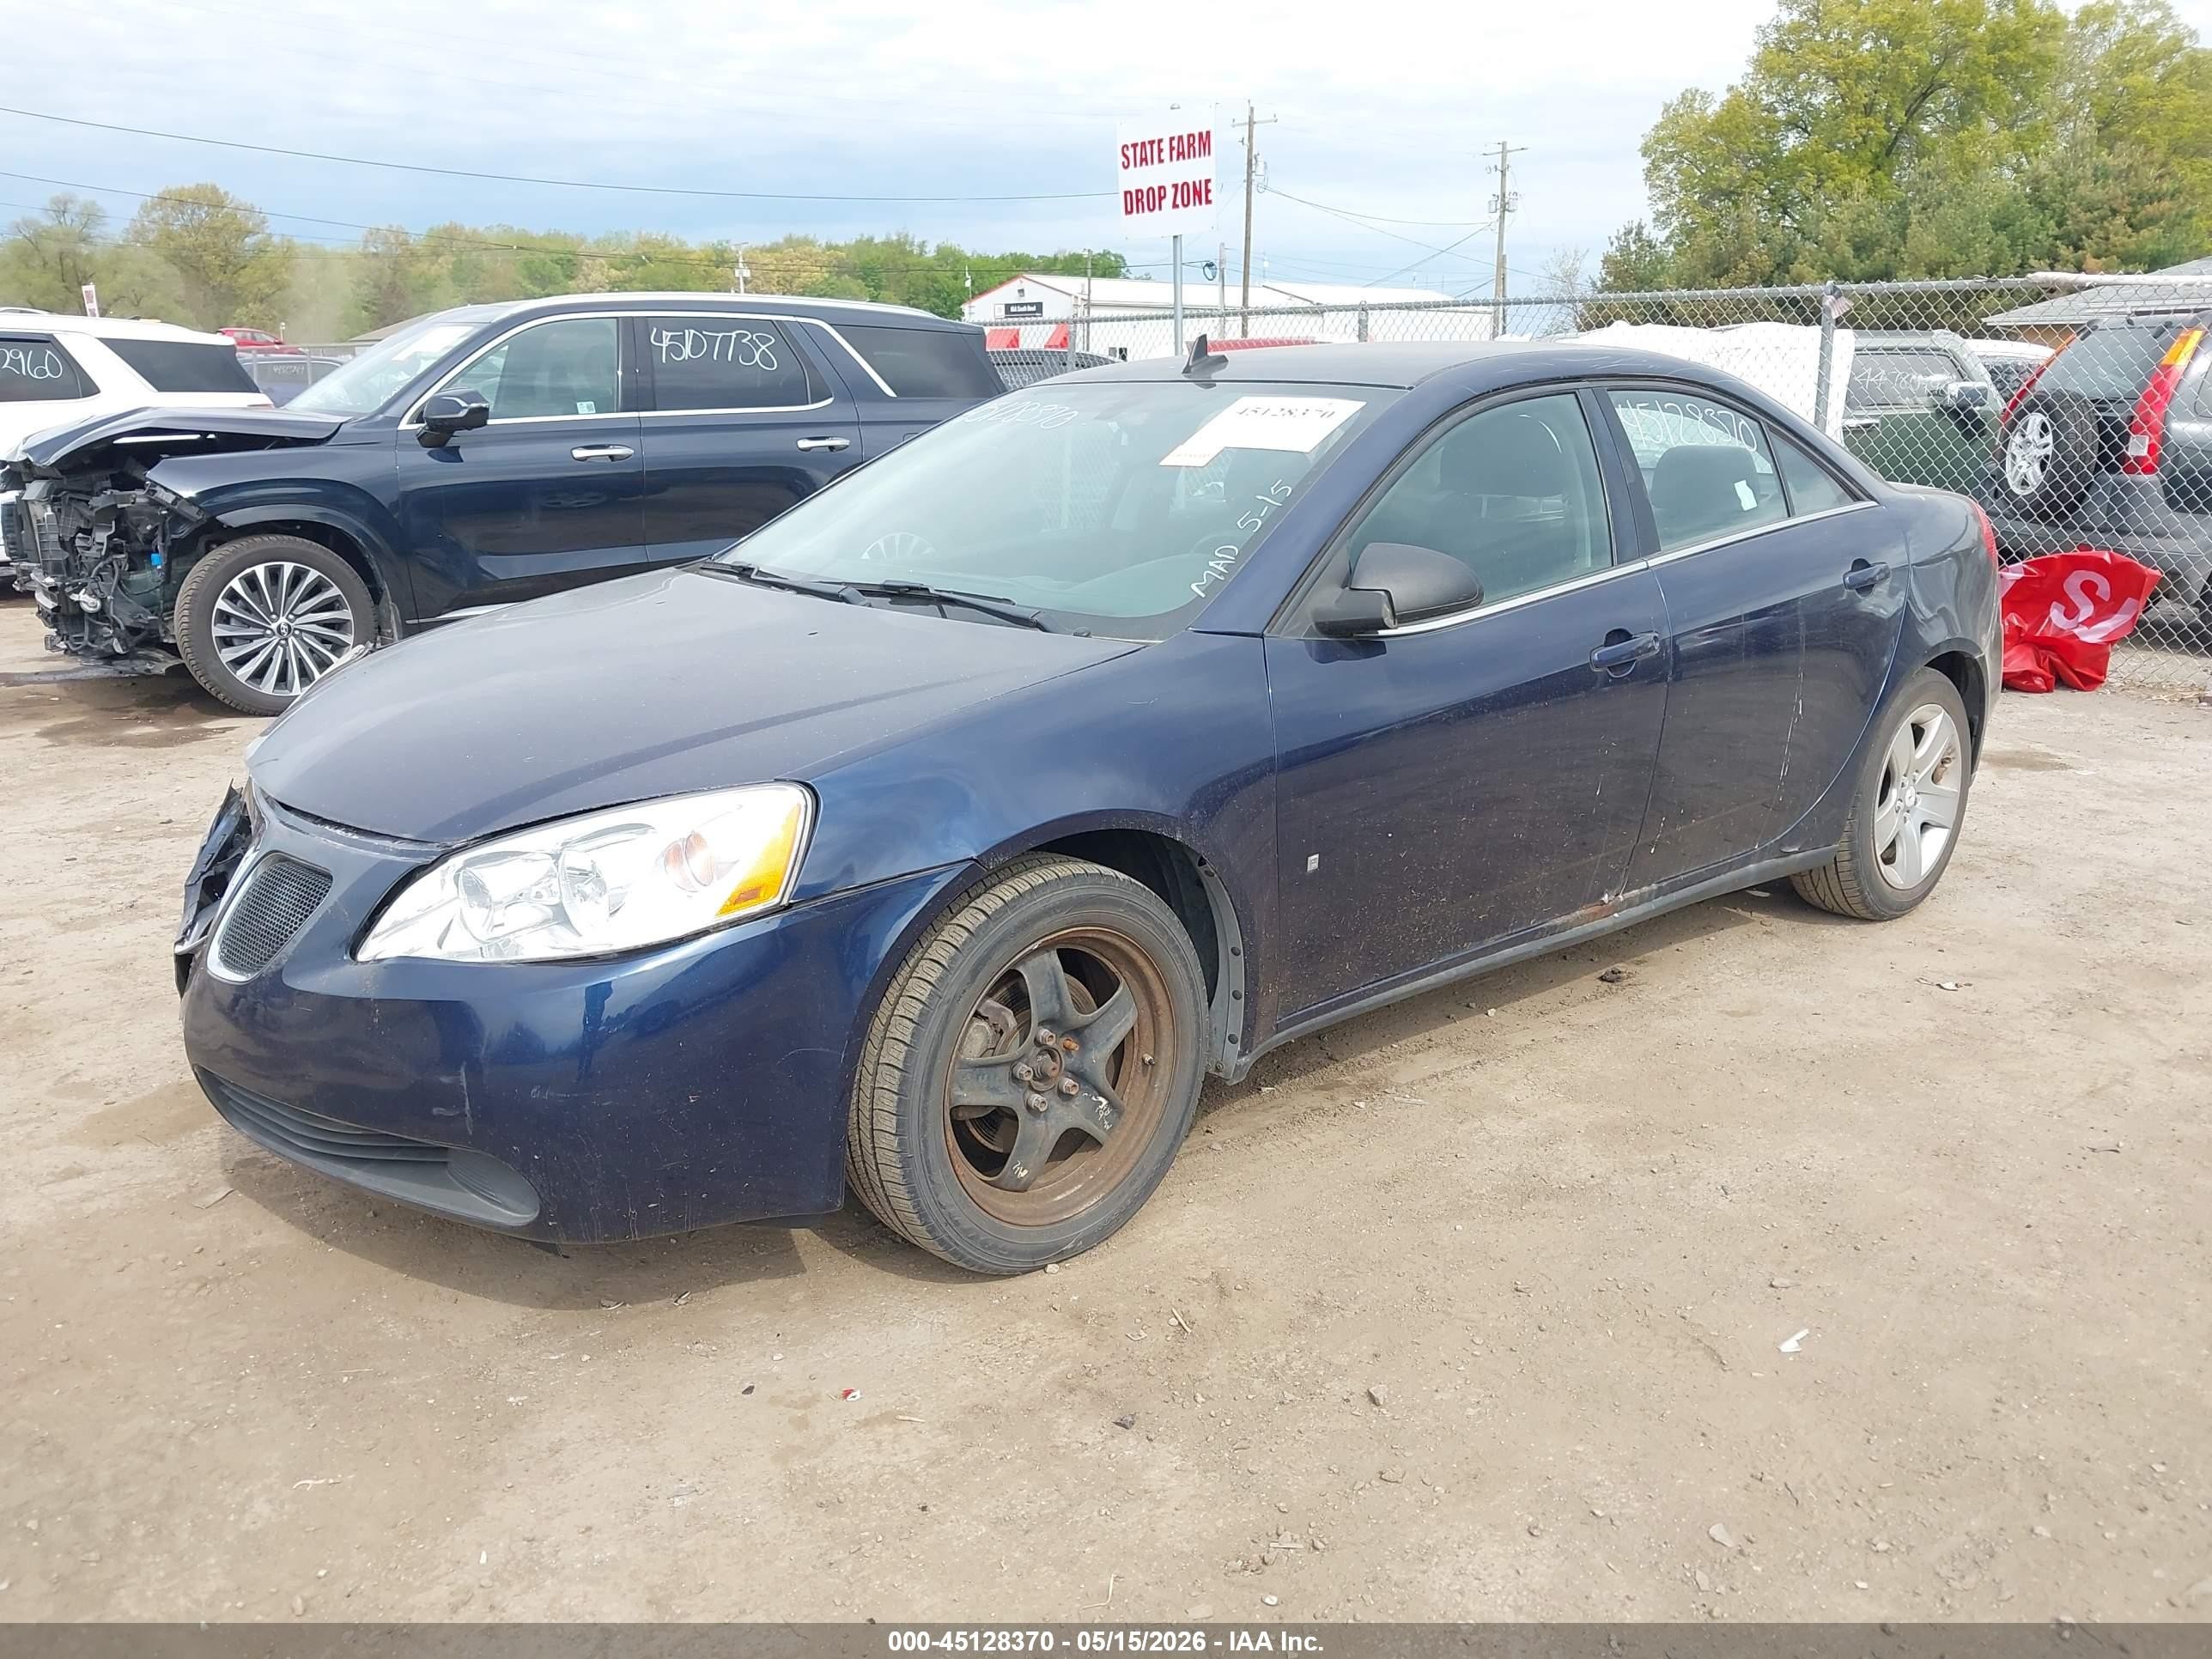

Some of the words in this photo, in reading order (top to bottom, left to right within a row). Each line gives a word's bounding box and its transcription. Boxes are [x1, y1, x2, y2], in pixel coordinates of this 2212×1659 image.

[1121, 137, 1164, 170] STATE
[1169, 130, 1211, 162] FARM
[1123, 185, 1167, 216] DROP
[1171, 178, 1212, 210] ZONE
[1614, 398, 1758, 453] 45128370
[1190, 544, 1239, 598] MAD
[1237, 478, 1292, 532] 5-15
